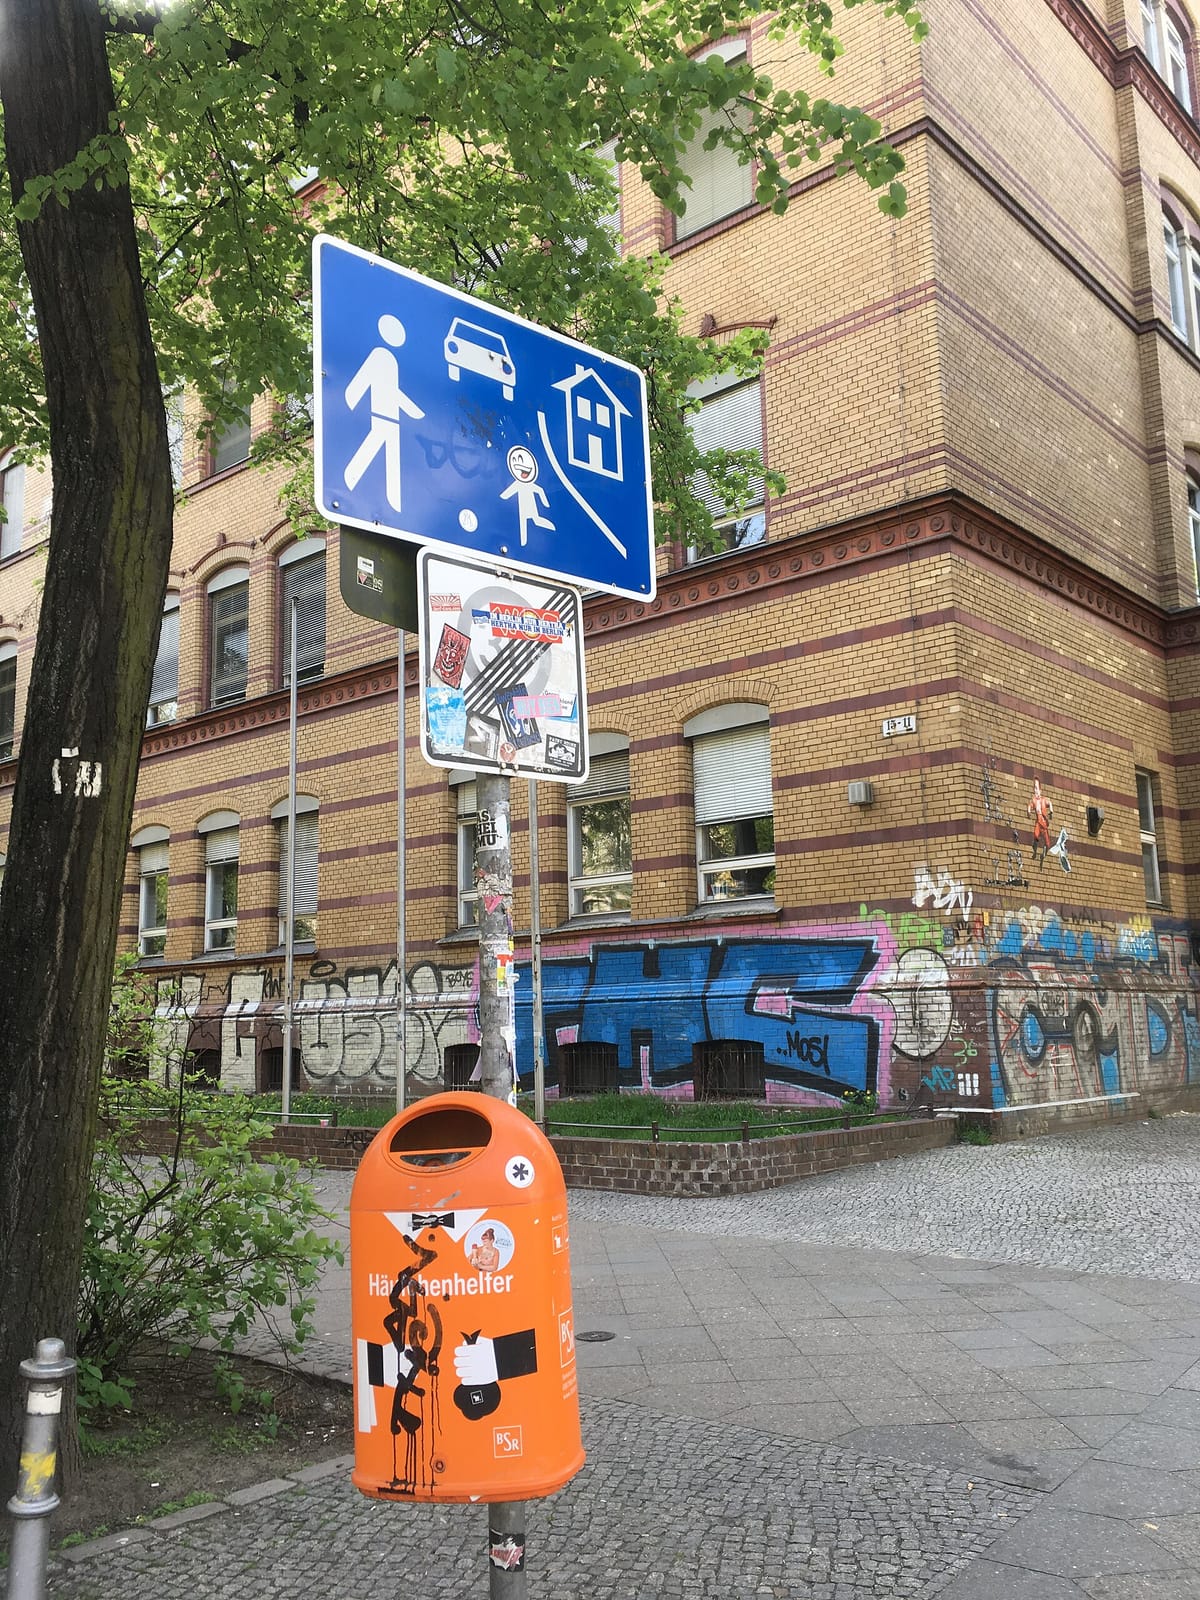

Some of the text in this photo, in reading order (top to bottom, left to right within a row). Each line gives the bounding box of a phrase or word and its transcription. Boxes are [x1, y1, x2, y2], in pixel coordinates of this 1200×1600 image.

[491, 620, 517, 630] HERTHA
[519, 624, 532, 632] NUR
[542, 627, 564, 636] BERLIN
[368, 1271, 514, 1297] Hähenhelfer
[496, 1432, 520, 1452] BSR
